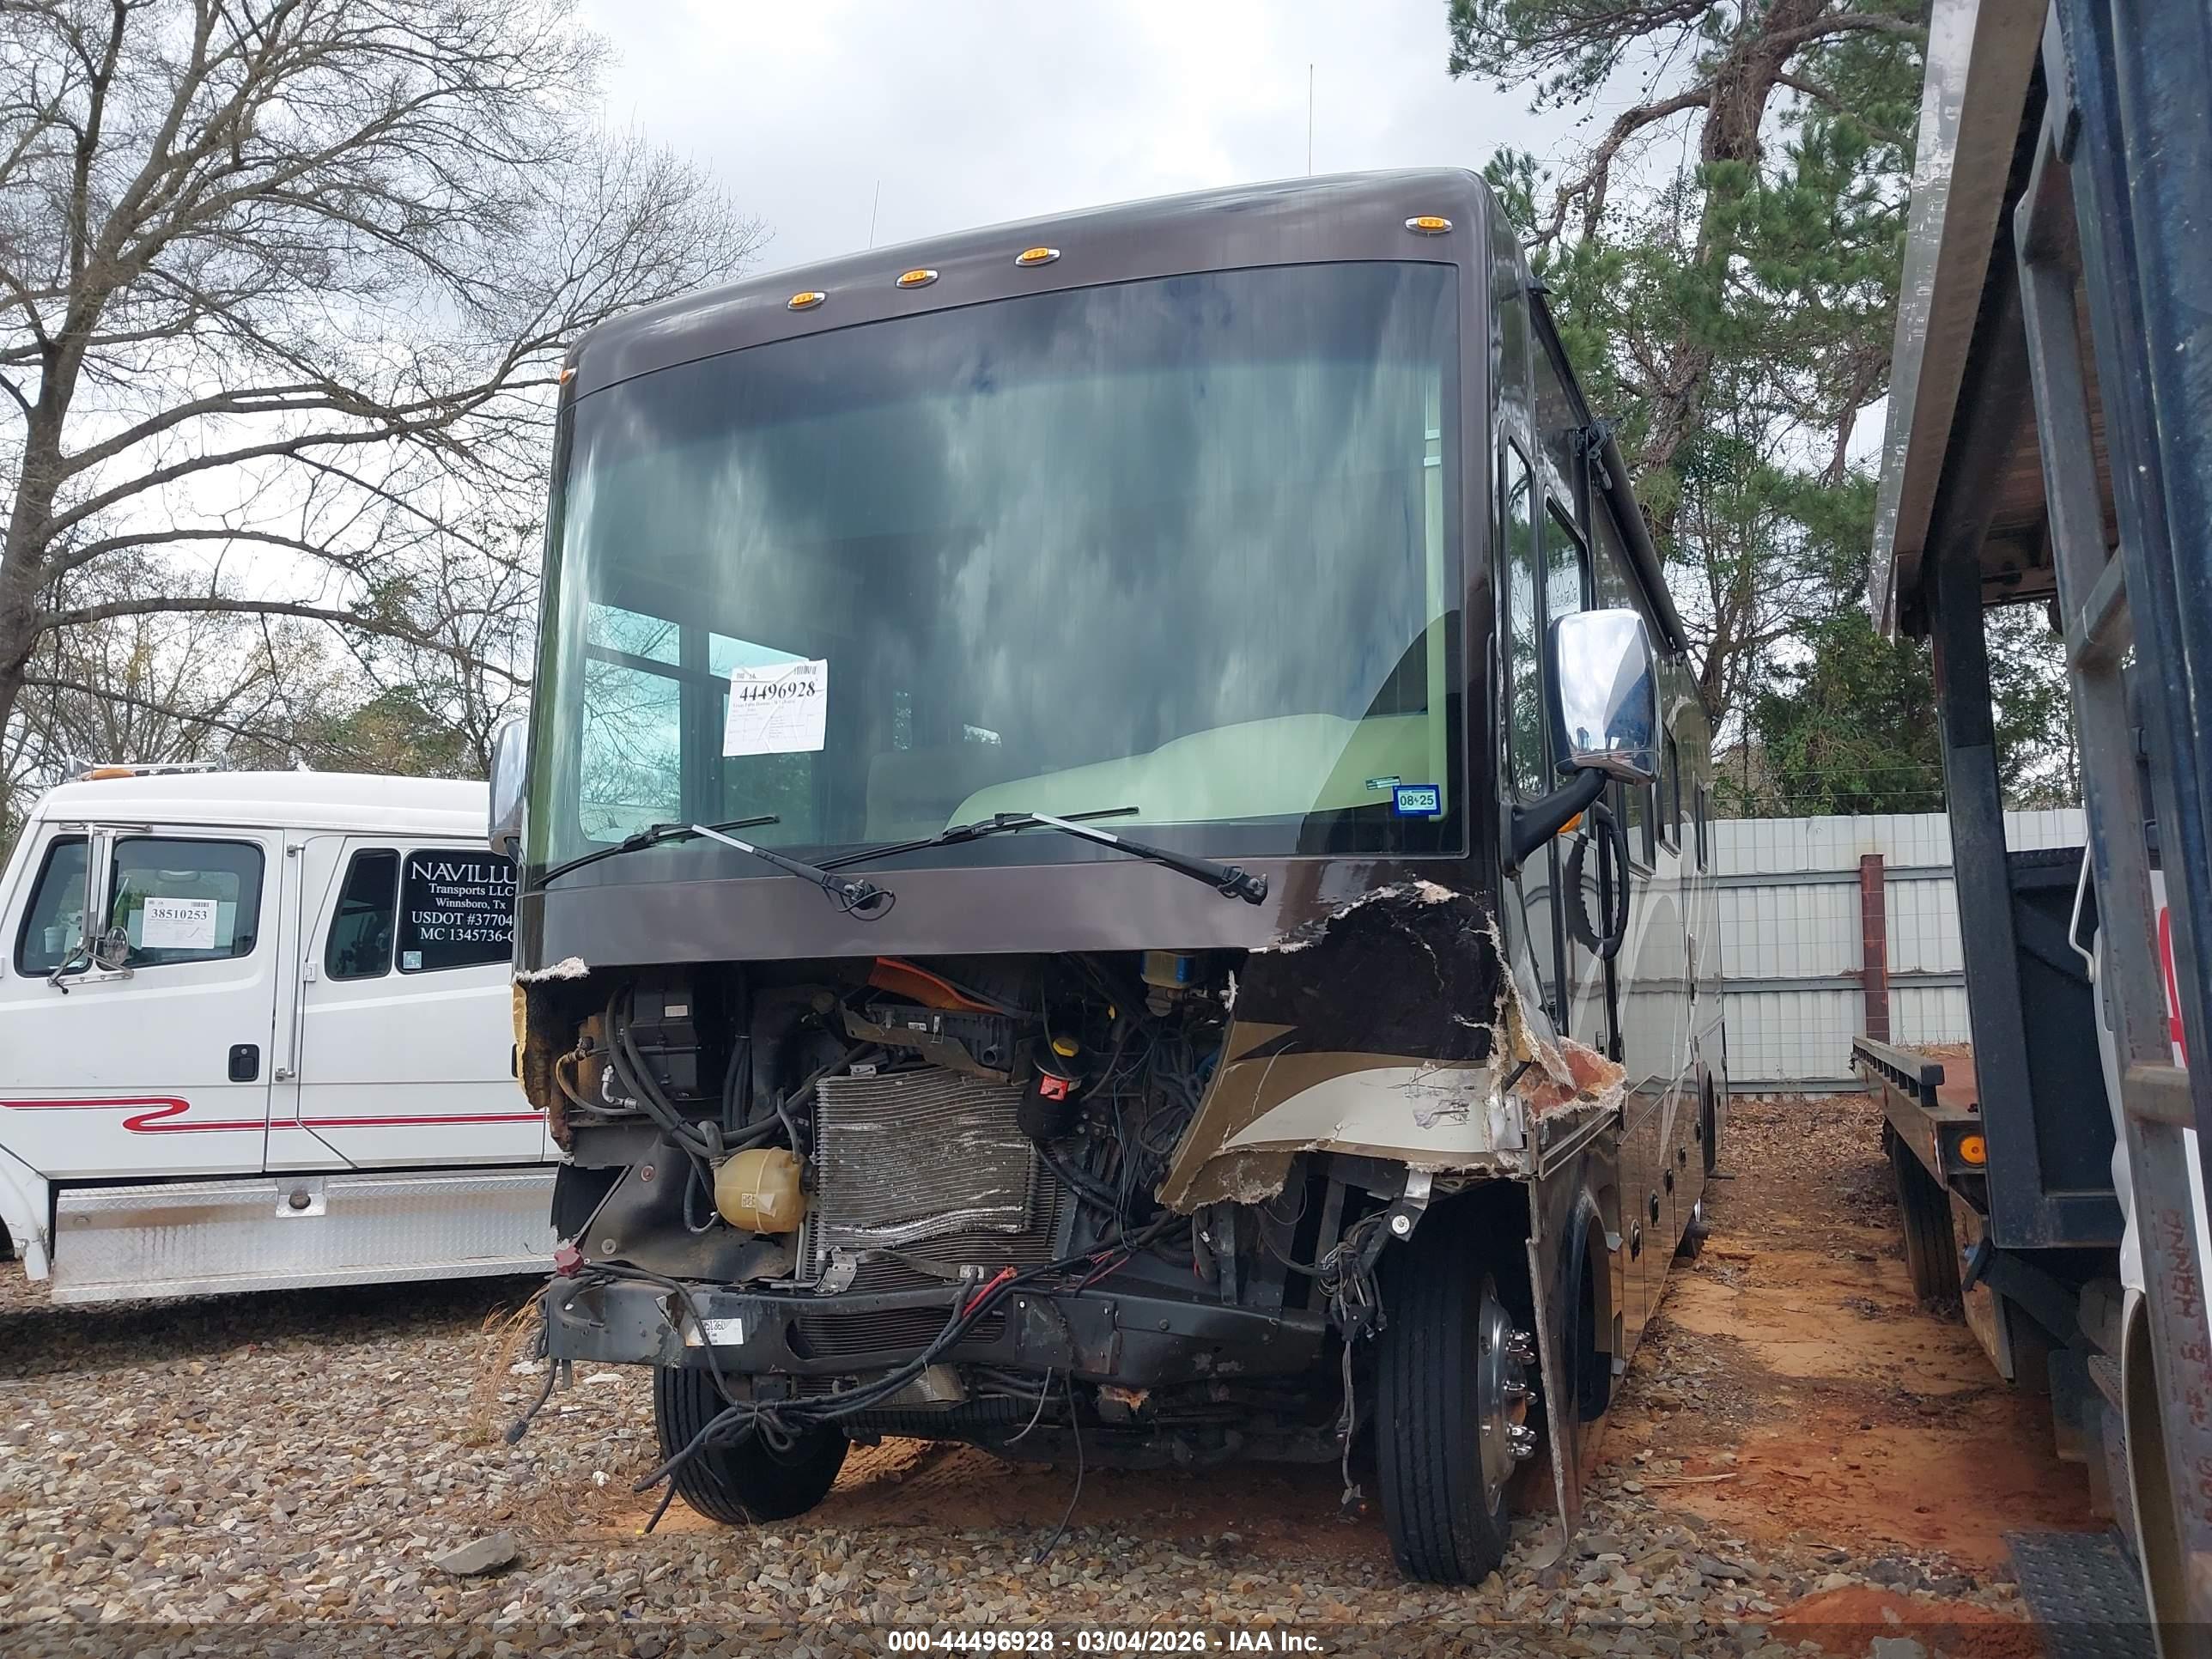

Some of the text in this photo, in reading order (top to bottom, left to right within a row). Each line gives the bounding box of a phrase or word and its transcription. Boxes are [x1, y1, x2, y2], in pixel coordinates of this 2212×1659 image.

[739, 681, 816, 702] 44496928
[1400, 795, 1434, 806] 08 25
[428, 883, 514, 897] Transports LLC
[435, 897, 507, 910] Winnsboro, Tx
[151, 908, 207, 921] 38510253
[411, 910, 514, 927] USDOT #37704
[420, 927, 446, 940] MC
